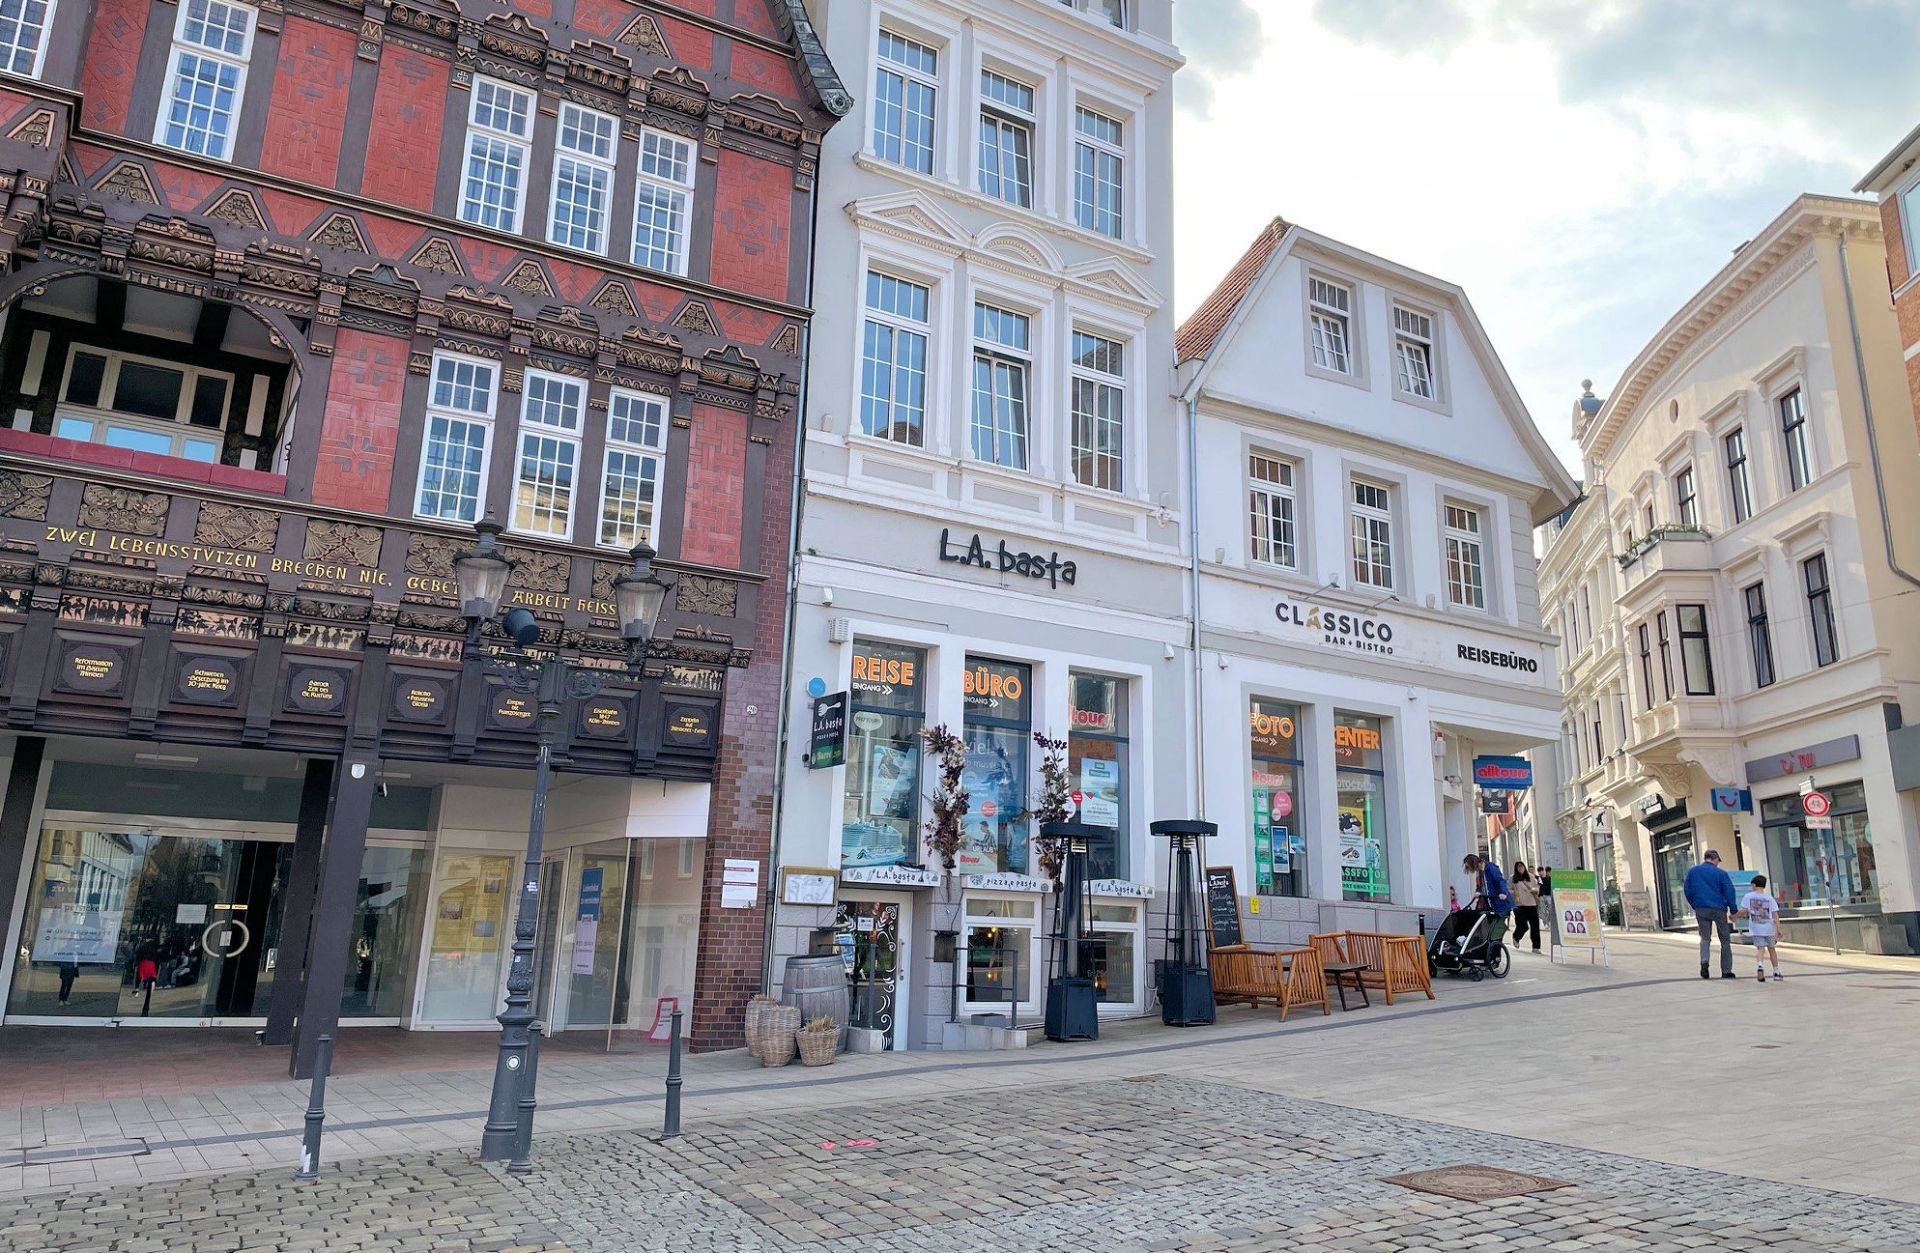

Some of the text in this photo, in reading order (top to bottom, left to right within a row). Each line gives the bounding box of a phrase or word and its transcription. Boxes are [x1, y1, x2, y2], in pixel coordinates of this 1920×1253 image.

[45, 527, 96, 547] ZWEI
[511, 591, 570, 609] ARBEIT
[577, 599, 617, 615] HEISS
[940, 528, 1076, 589] L.A. basta
[1275, 603, 1393, 642] CLASSICO
[1325, 635, 1346, 645] BAR
[1356, 640, 1393, 654] BISTRO
[1457, 643, 1537, 673] REISEBÜRO
[853, 655, 915, 686] REISE
[964, 666, 1022, 700] BÜRO
[1477, 764, 1530, 779] alltours
[893, 871, 916, 882] basta
